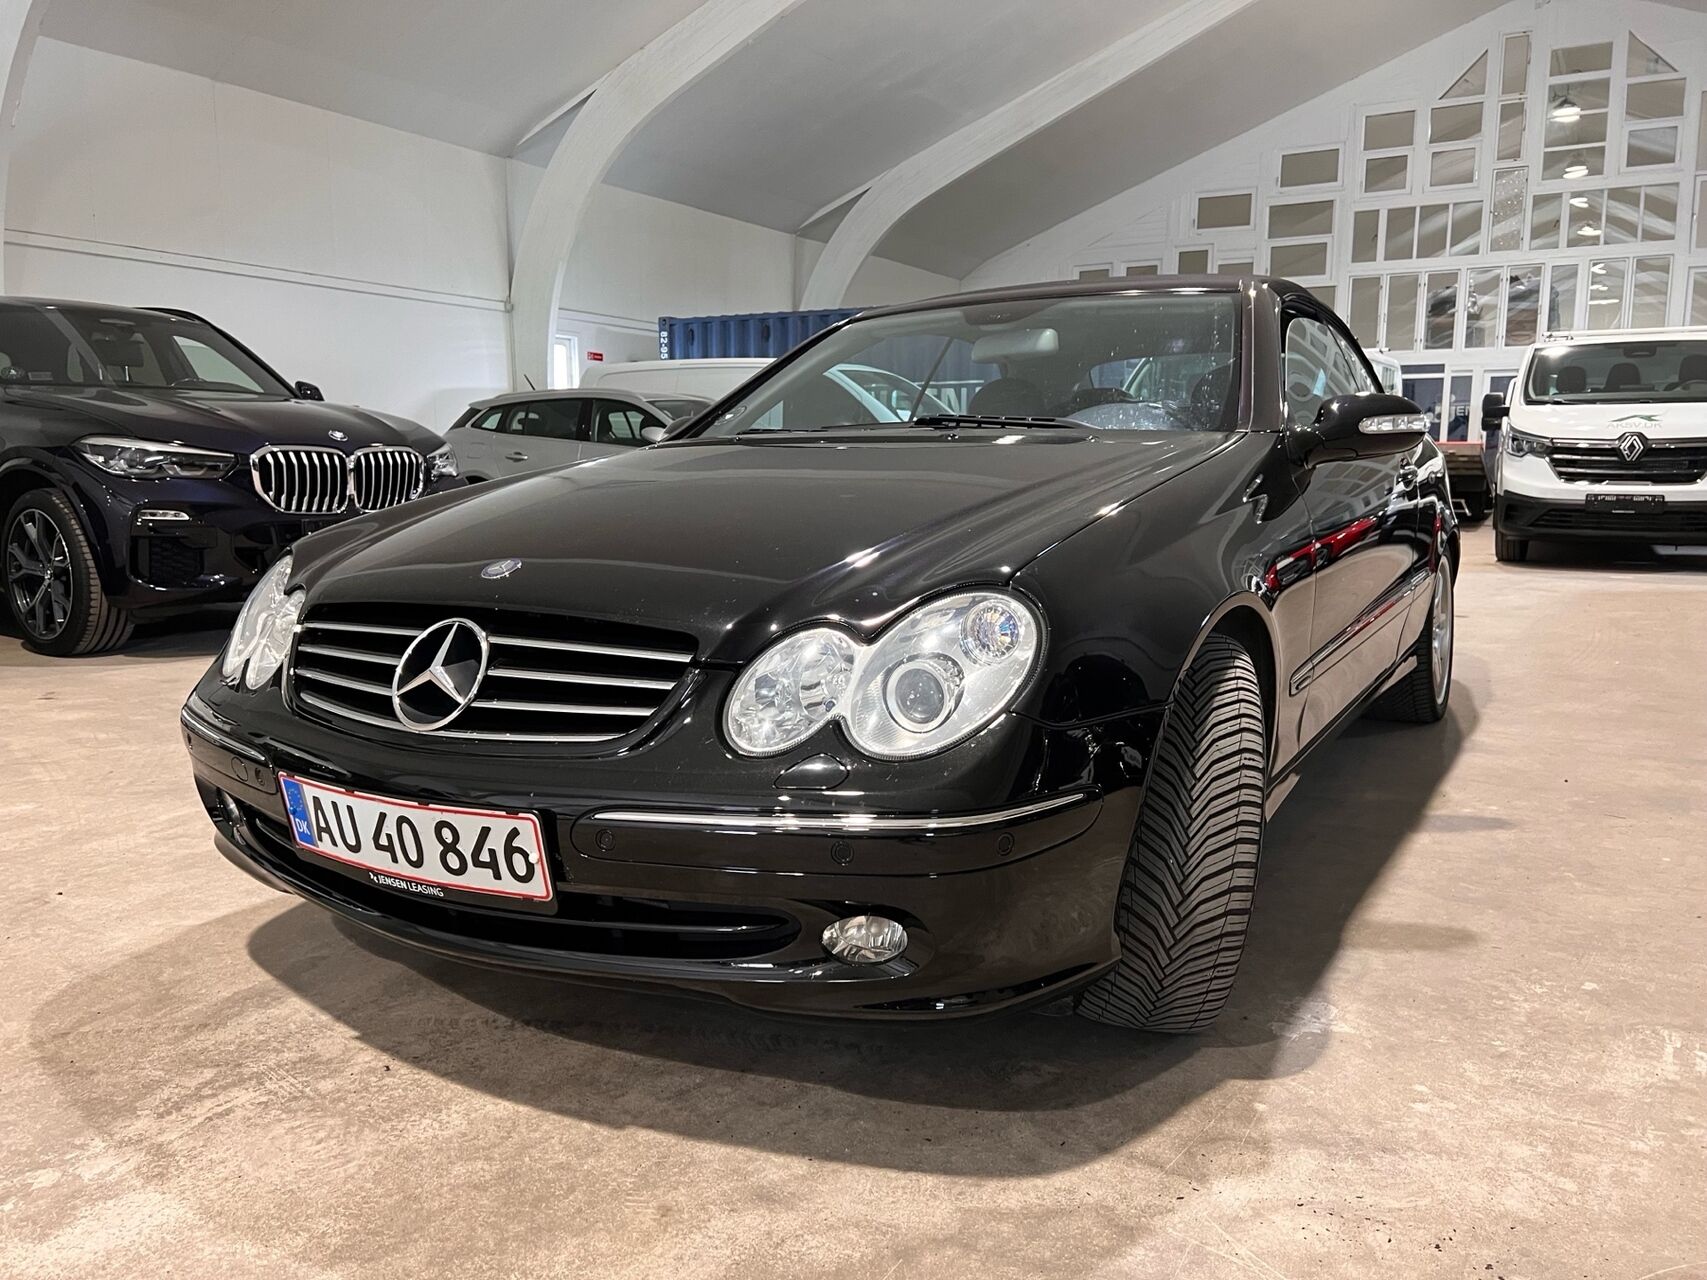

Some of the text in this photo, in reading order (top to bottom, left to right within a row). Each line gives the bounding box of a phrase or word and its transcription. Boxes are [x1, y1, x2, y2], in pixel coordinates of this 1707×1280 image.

[295, 817, 311, 835] DK
[312, 795, 535, 884] AU 40 846
[378, 875, 444, 897] JENSEN LEASING
